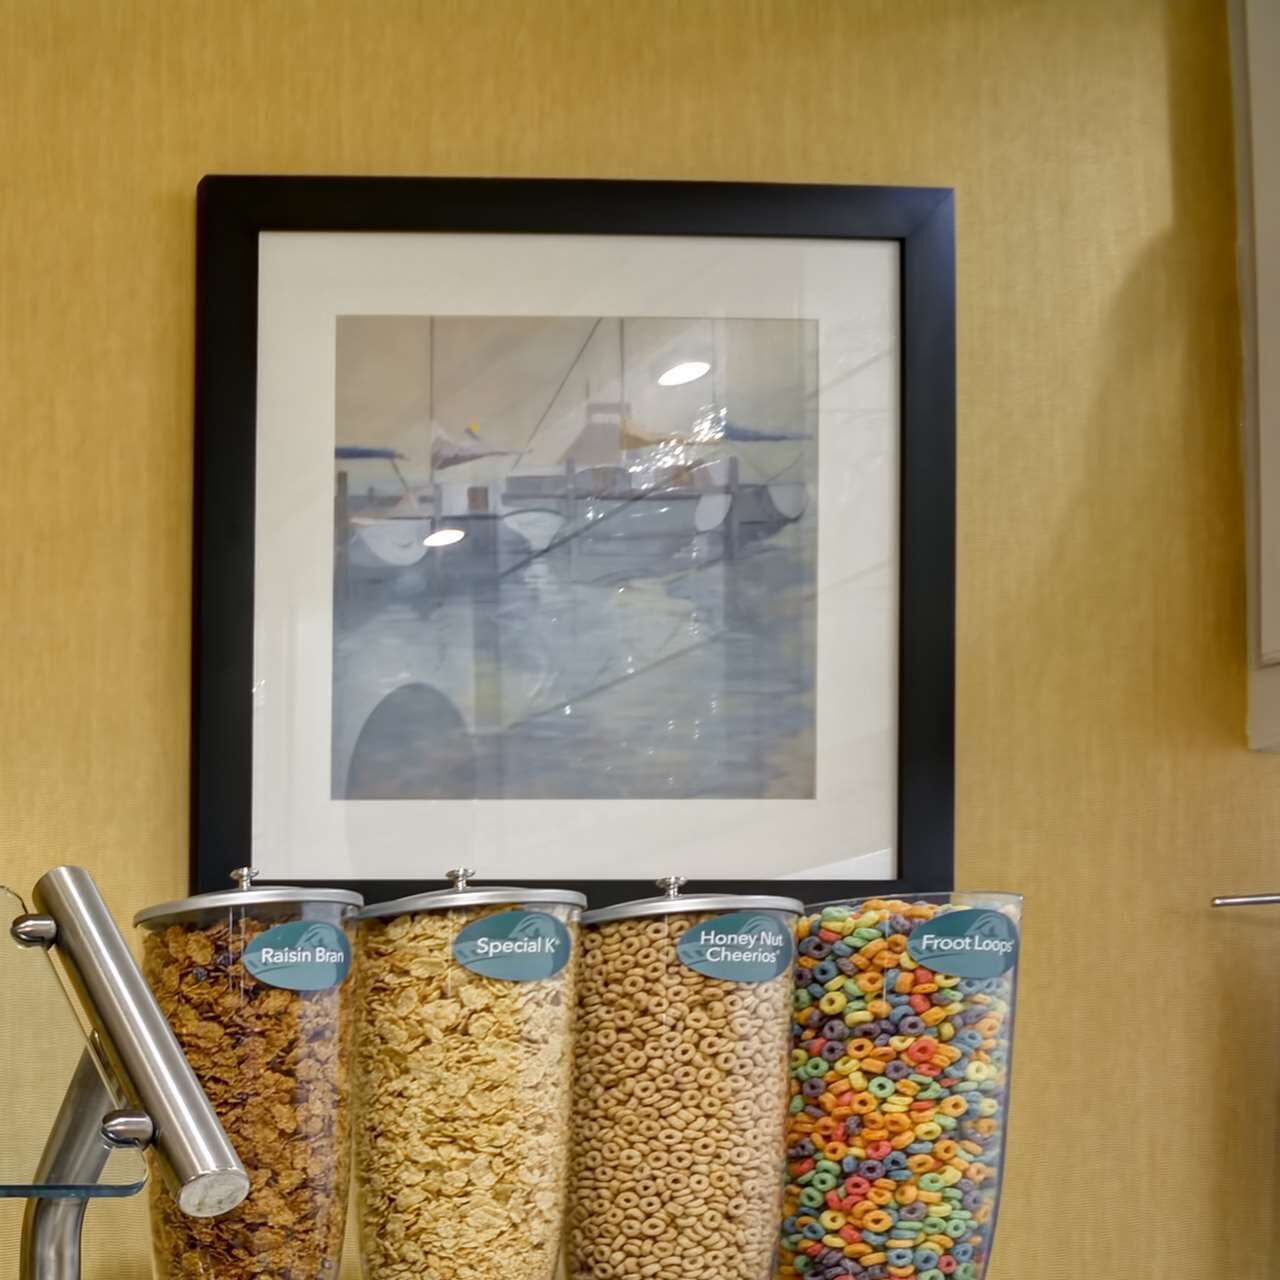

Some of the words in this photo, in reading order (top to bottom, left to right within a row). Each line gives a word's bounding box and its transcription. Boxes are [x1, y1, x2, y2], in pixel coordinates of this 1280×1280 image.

[476, 937, 542, 958] Special
[700, 930, 759, 948] Honey
[760, 931, 784, 947] Nut
[921, 934, 973, 951] Froot
[973, 935, 1014, 956] Loops
[261, 947, 313, 964] Raisin
[315, 947, 345, 963] Bran
[706, 946, 778, 963] Cheerios
